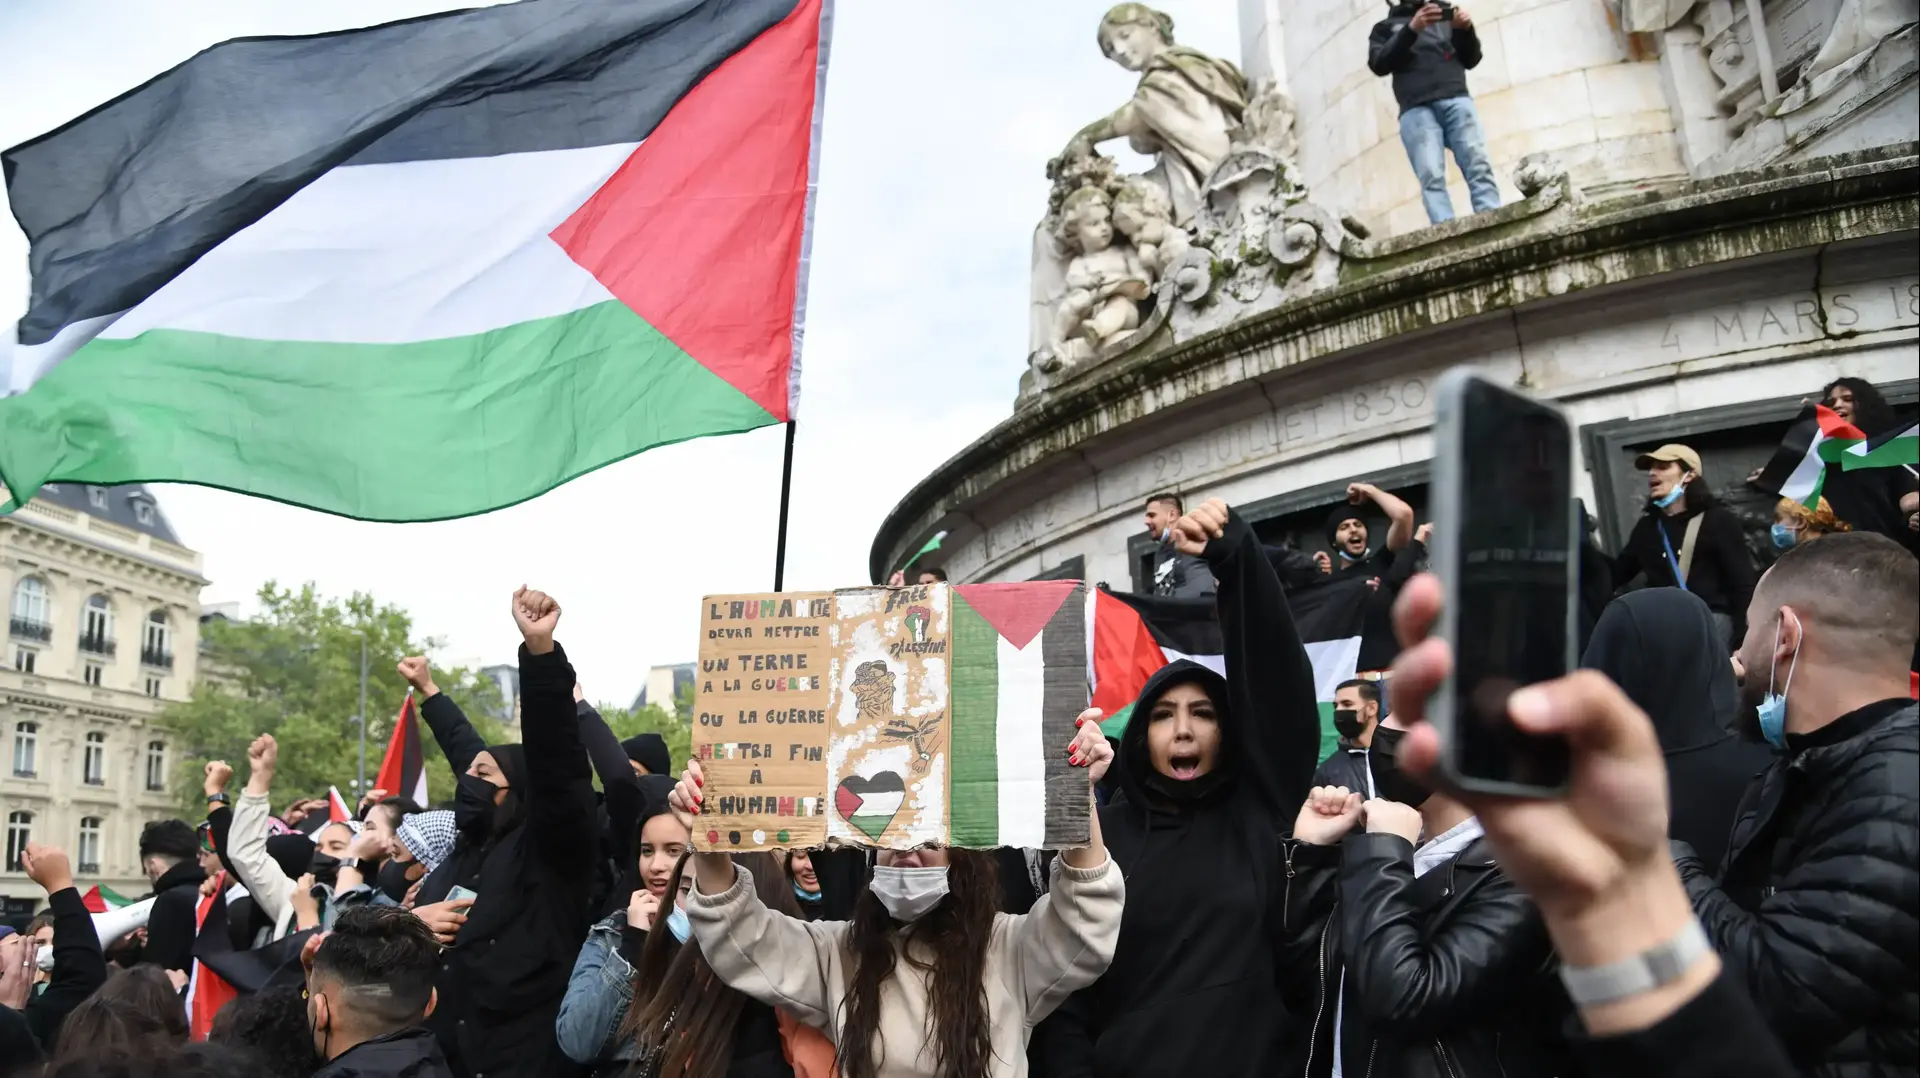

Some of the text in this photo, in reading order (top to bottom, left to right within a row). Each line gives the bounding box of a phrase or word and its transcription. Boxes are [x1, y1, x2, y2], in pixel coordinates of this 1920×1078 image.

[1660, 323, 1682, 353] 4
[1713, 293, 1860, 347] MARS
[1154, 378, 1427, 483] 29 JUILLET 1830
[885, 585, 929, 614] FREE
[708, 626, 820, 639] DEVRA METTRE
[889, 636, 947, 659] PALESTINE
[703, 654, 808, 673] UN TERME
[703, 676, 820, 693] A LA GUERRE
[700, 708, 825, 727] OU LA GUERRE
[700, 743, 823, 761] METTRA FIN
